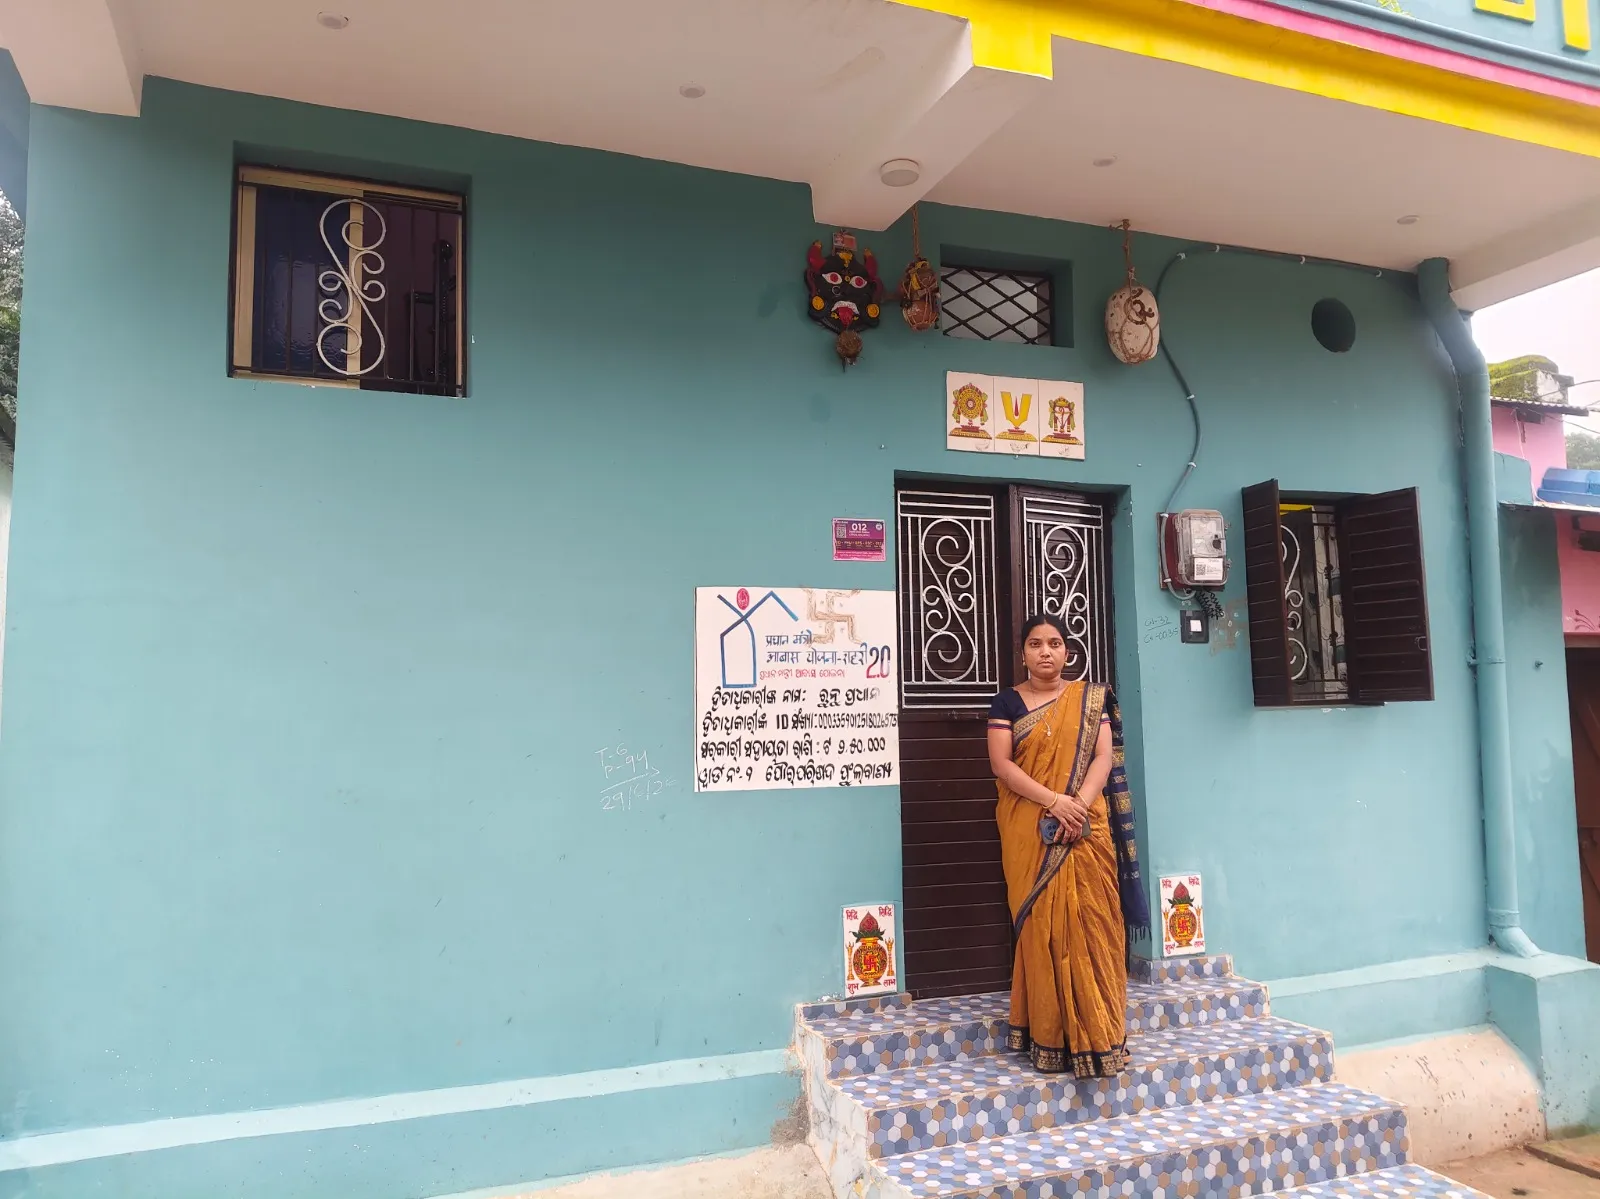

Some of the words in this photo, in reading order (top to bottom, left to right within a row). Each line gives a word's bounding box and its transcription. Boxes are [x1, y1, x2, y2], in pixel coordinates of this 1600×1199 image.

[866, 645, 891, 679] 2.0
[775, 713, 789, 730] ID
[848, 983, 859, 994] शुभ
[884, 979, 896, 987] लाभ
